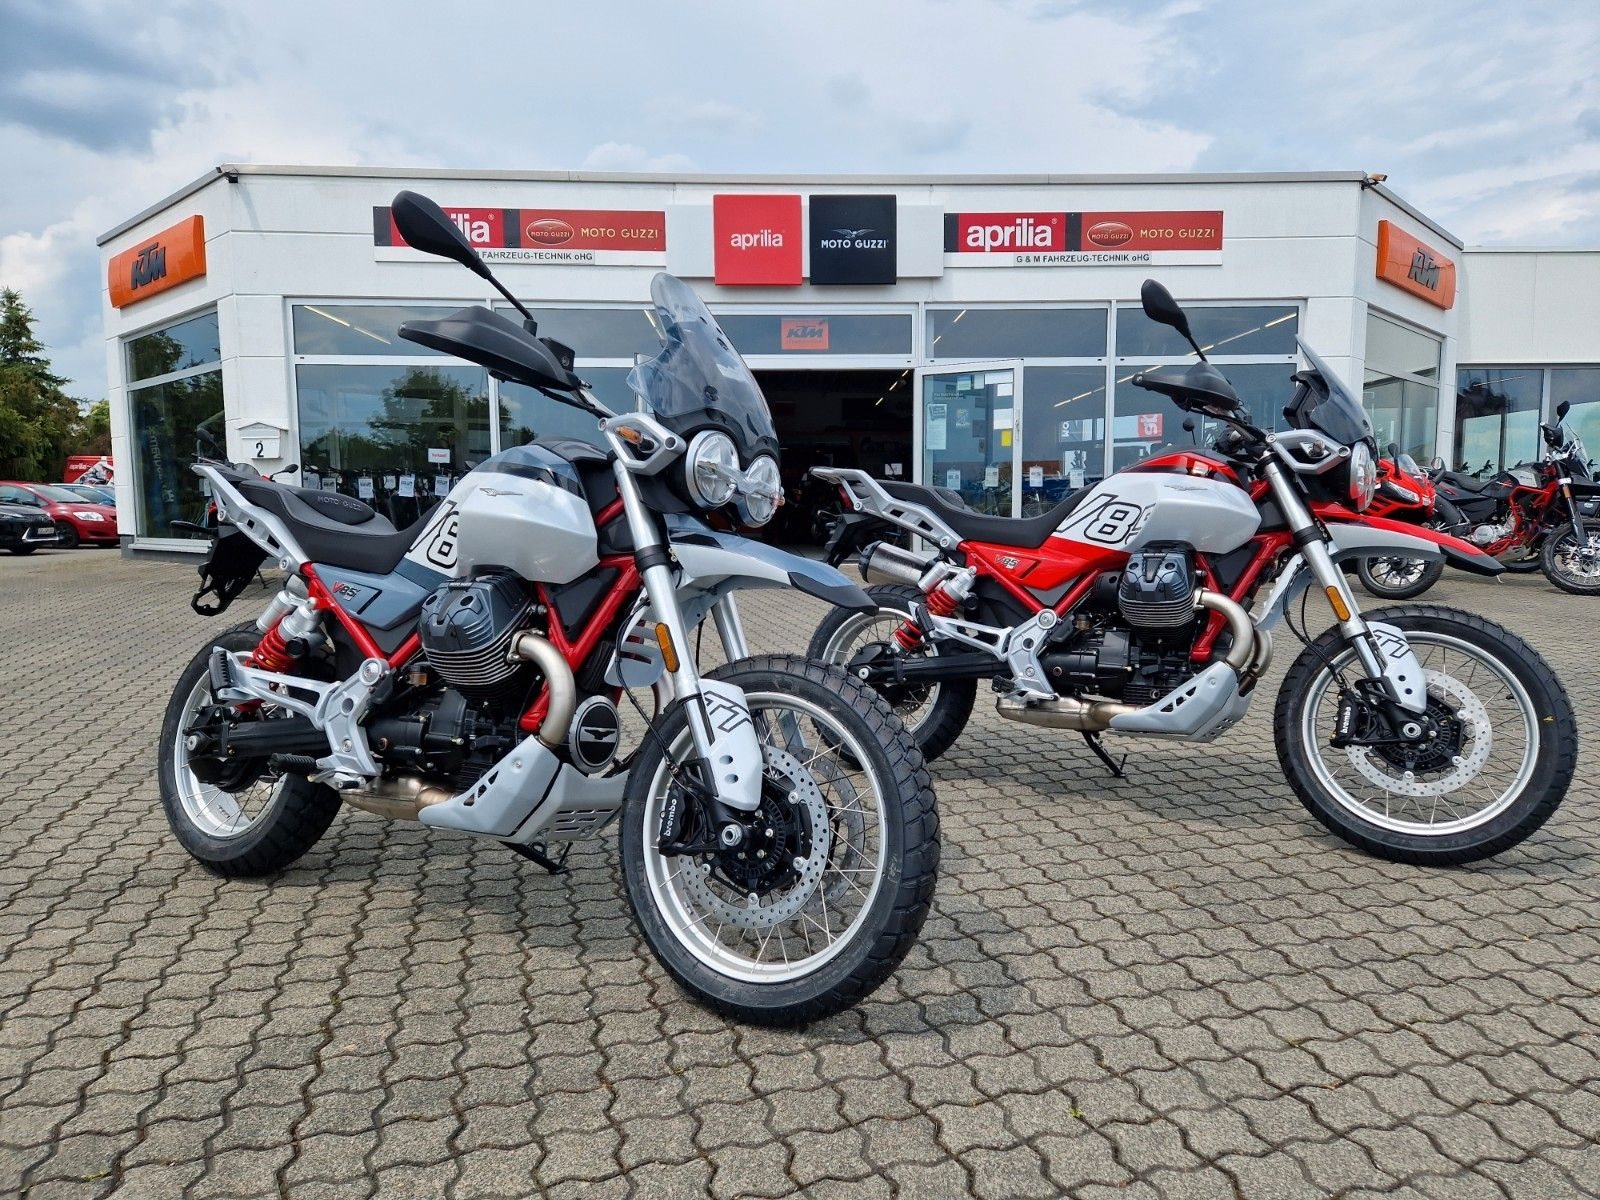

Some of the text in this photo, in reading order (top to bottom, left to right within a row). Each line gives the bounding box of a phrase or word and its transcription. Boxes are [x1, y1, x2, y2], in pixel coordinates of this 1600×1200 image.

[581, 227, 658, 239] MOTO GUZZI
[730, 229, 783, 250] aprilia
[966, 218, 1052, 252] aprilia
[1140, 228, 1215, 239] MOTO GUZZI
[821, 240, 887, 249] MOTO GUZZI
[482, 251, 572, 260] FAHRZEUG-TECHNIK
[574, 253, 593, 261] oHG
[1016, 255, 1023, 263] G
[1033, 255, 1041, 263] M
[1042, 254, 1130, 263] FAHRZEUG-TECHNIK
[1131, 253, 1150, 262] oHG
[131, 242, 167, 290] KTM
[1407, 247, 1440, 292] KTM
[786, 325, 824, 338] KTM
[255, 442, 265, 458] 2
[317, 495, 340, 505] MOTO
[1340, 706, 1351, 734] brembo
[663, 798, 677, 837] brembo
